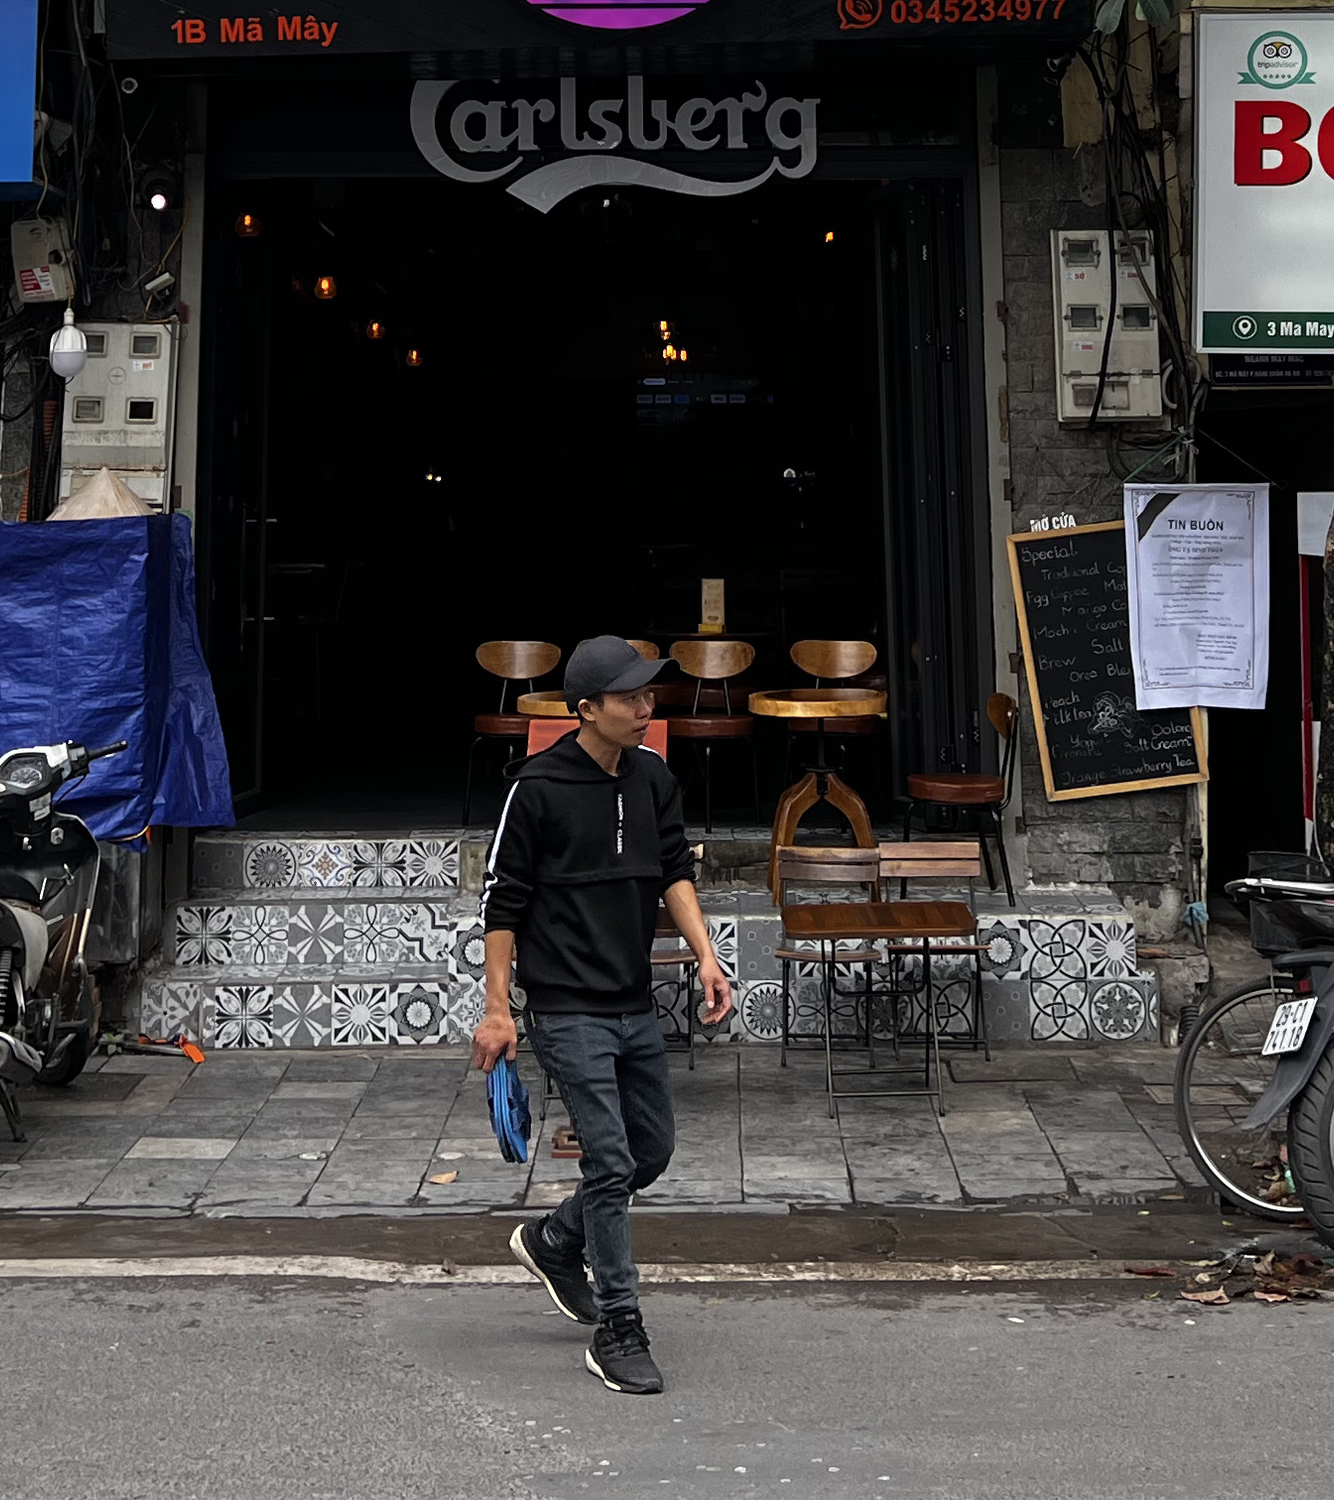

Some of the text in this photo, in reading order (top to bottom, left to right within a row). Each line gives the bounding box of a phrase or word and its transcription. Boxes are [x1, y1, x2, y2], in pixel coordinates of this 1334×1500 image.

[170, 15, 339, 47] 1B Mã Mây
[1256, 60, 1298, 70] tripadvisor
[410, 74, 822, 183] Carlsberg
[1267, 322, 1277, 339] 3
[1279, 322, 1303, 339] Ma
[1051, 511, 1077, 530] CỬA
[1167, 519, 1187, 531] TIN
